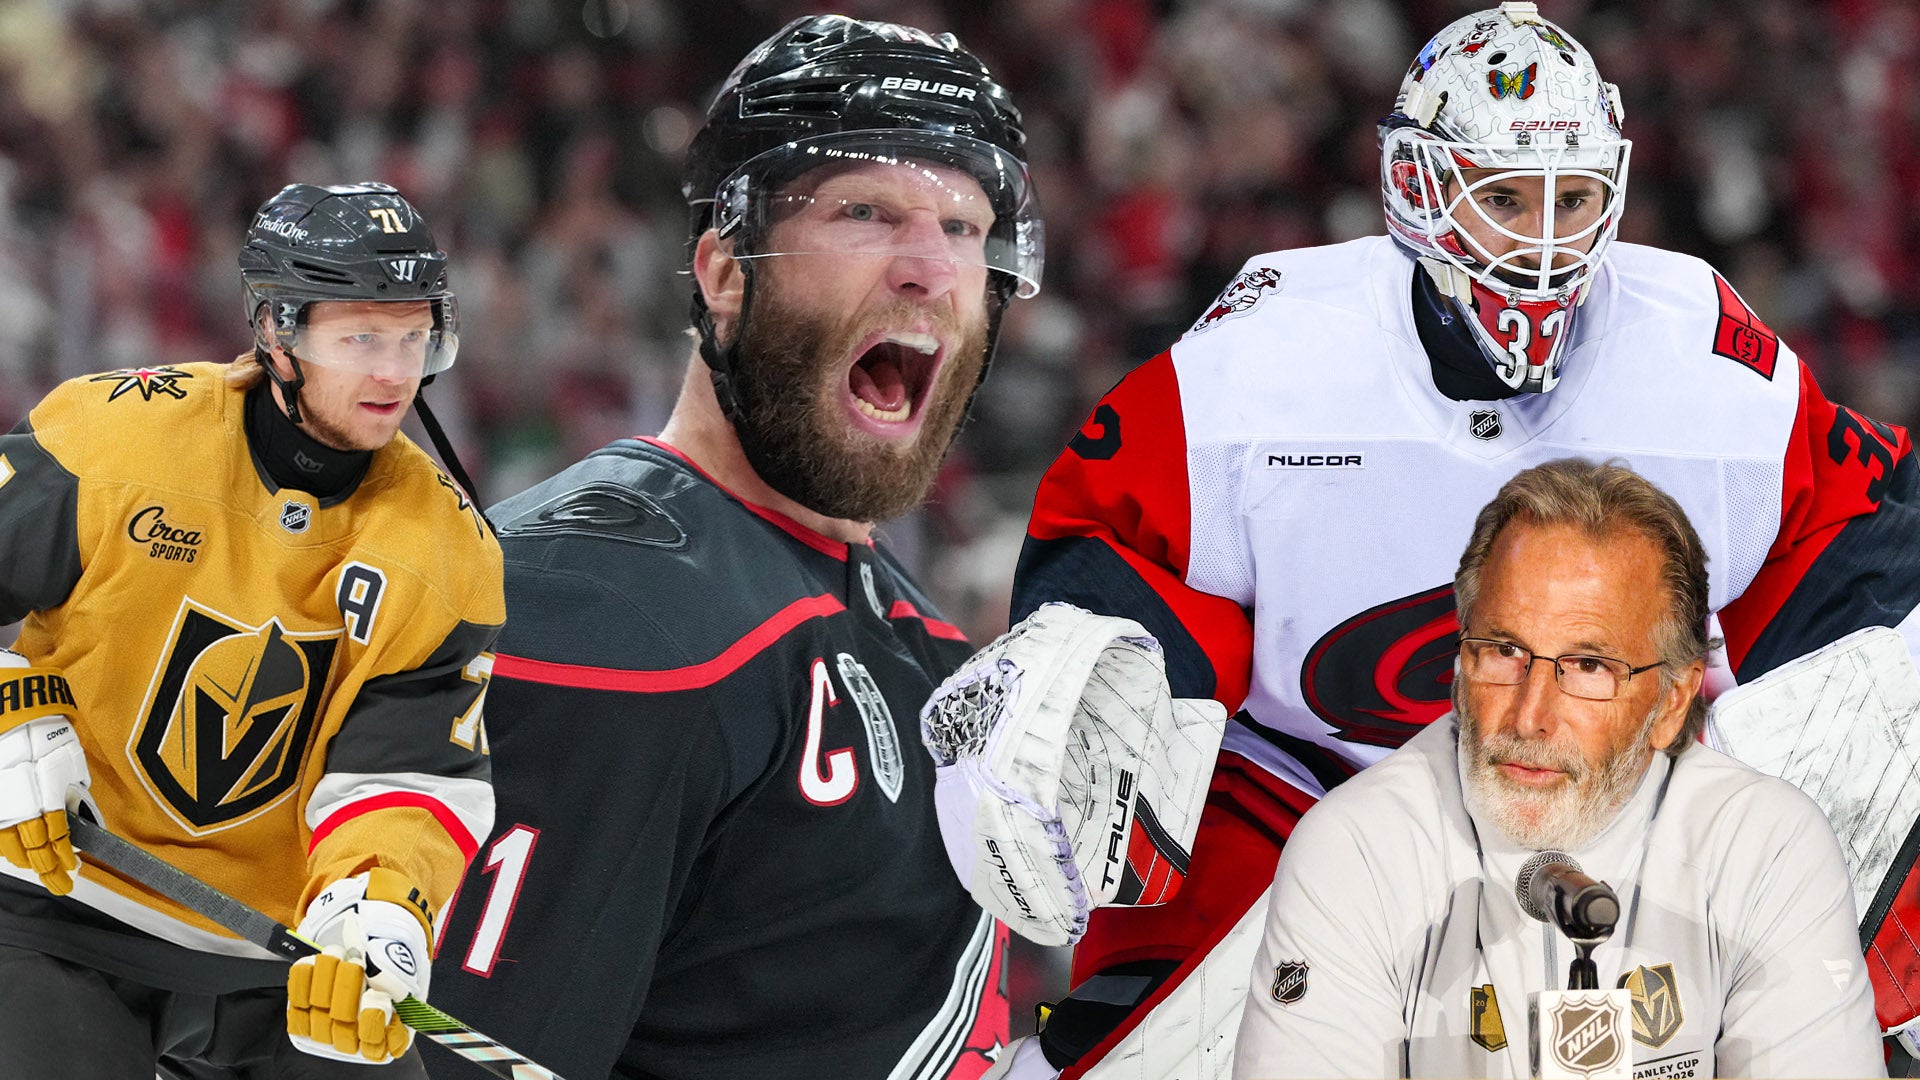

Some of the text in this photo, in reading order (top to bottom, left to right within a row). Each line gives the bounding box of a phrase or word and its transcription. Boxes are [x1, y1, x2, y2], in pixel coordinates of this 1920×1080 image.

[881, 77, 977, 101] BAUER
[1508, 121, 1581, 131] BAUER
[369, 208, 408, 233] 71
[1496, 308, 1568, 393] 32
[1476, 418, 1496, 435] NHL
[1268, 455, 1362, 466] NUCOR
[128, 506, 202, 546] Circa
[285, 510, 307, 526] NHL
[150, 542, 198, 564] SPORTS
[335, 560, 388, 646] A
[0, 674, 78, 716] ARRI
[449, 651, 496, 755] 7
[47, 727, 69, 741] COVERT
[798, 656, 860, 807] C
[1101, 768, 1134, 892] TRUE
[985, 839, 1038, 919] HZRDUS
[320, 892, 334, 906] 71
[433, 823, 541, 978] 1
[1277, 971, 1303, 997] NHL
[1567, 1016, 1609, 1059] NHL
[1633, 1059, 1699, 1079] TANLEY CUP
